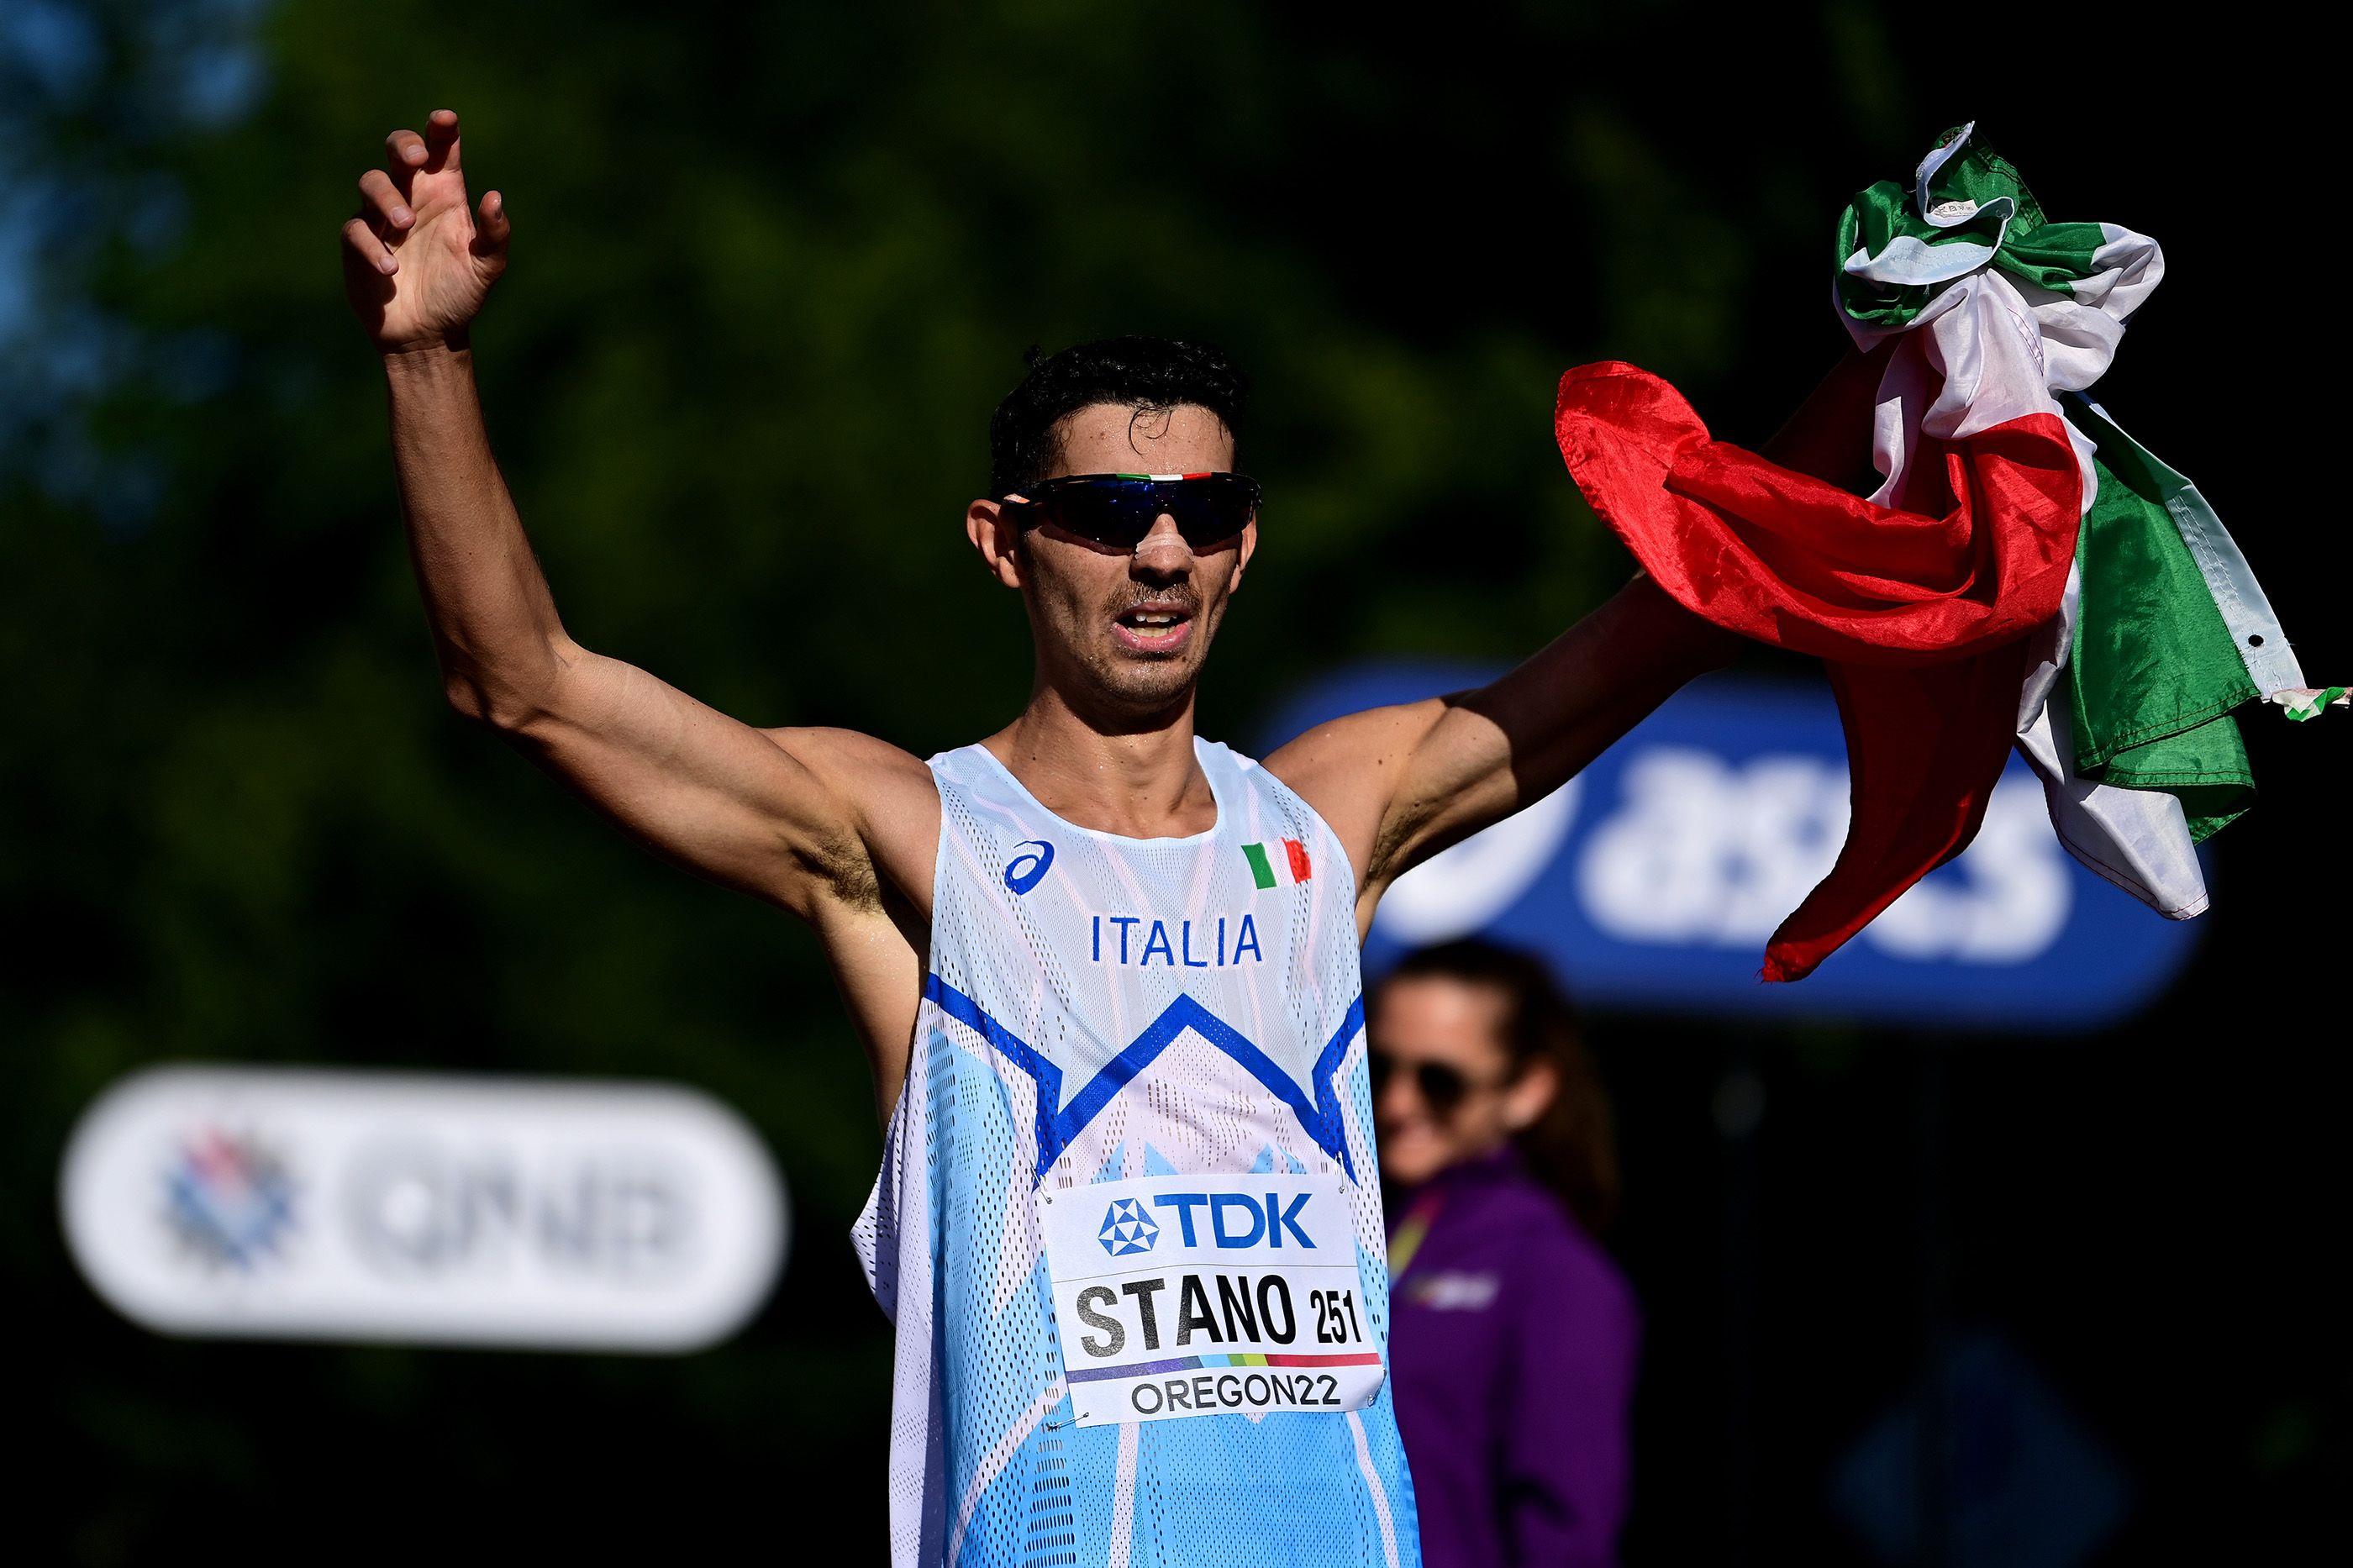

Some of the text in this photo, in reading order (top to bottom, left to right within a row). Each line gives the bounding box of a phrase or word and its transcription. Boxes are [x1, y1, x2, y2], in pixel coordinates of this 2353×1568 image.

[1091, 913, 1263, 968] ITALIA
[1154, 1192, 1317, 1250] TDK
[1076, 1274, 1297, 1358] STANO
[1310, 1289, 1362, 1344] 251
[1131, 1374, 1341, 1414] OREGON22
